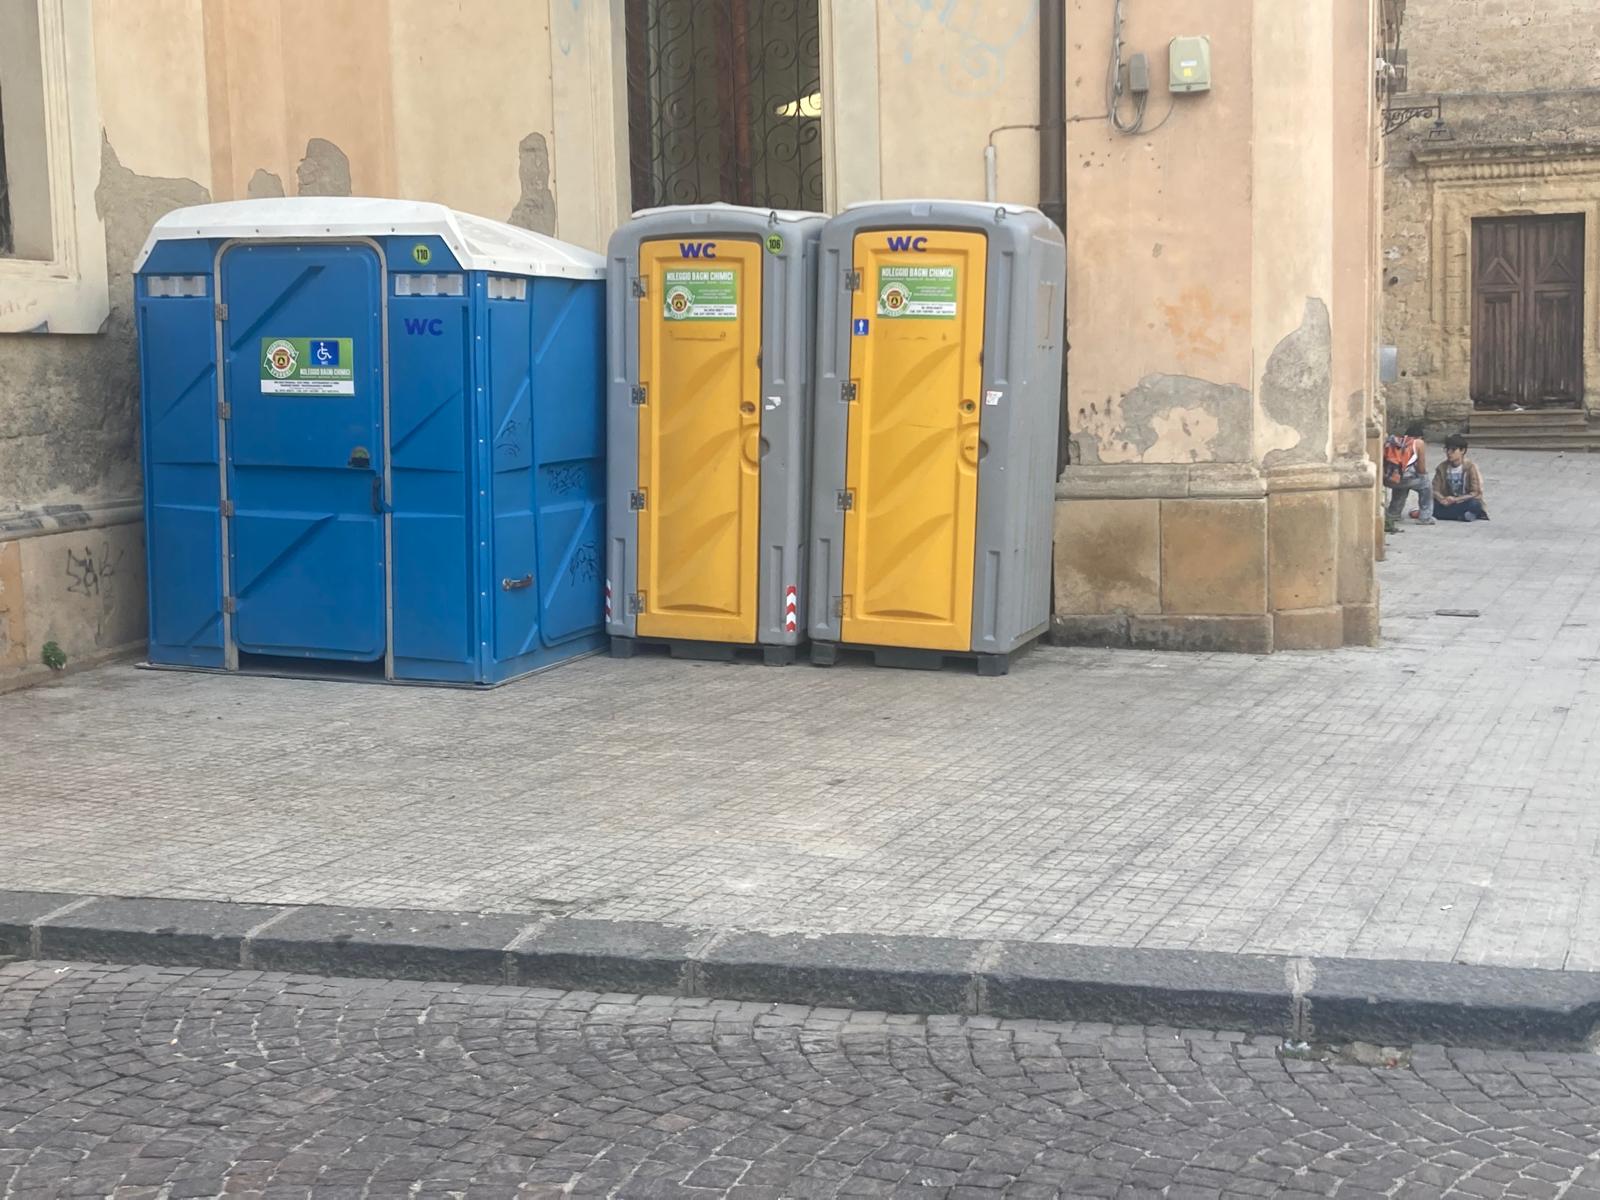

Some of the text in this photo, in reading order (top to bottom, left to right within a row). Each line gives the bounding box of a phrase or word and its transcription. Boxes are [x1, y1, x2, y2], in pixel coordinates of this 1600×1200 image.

[680, 242, 717, 259] WC
[887, 236, 928, 253] WC
[416, 249, 428, 260] 110
[666, 271, 734, 281] NOLEGGIO BAGNI CHIMICI
[881, 267, 909, 278] NOLEGGIO
[909, 267, 929, 278] BAGNI
[404, 318, 443, 336] WC
